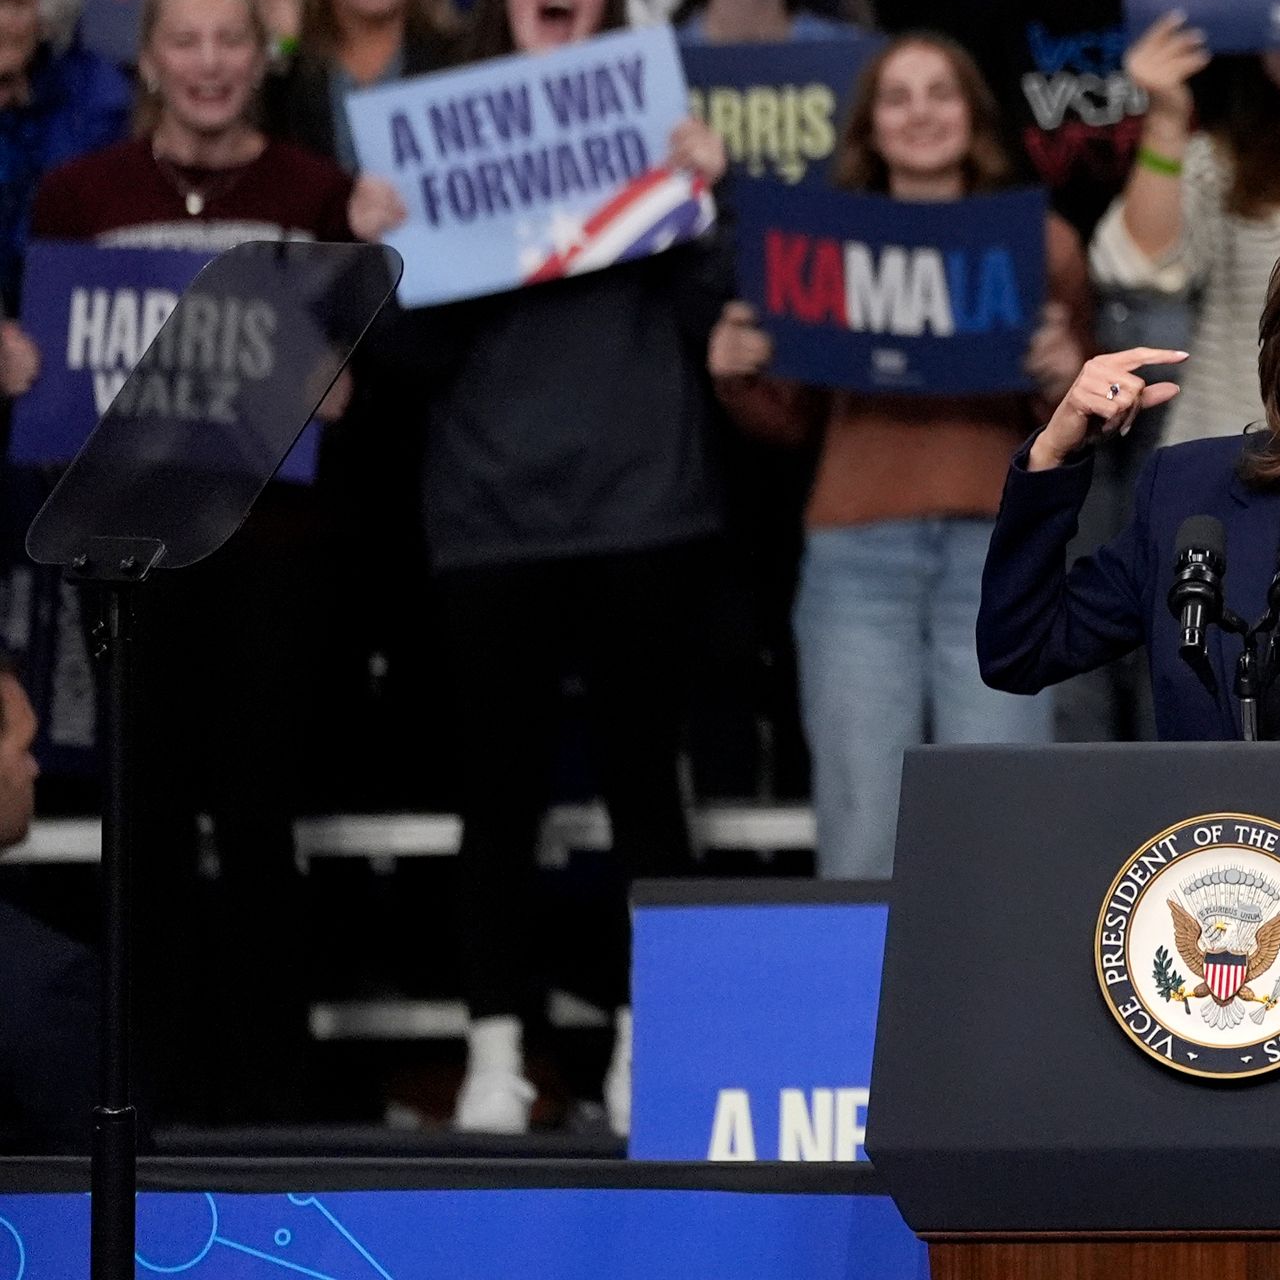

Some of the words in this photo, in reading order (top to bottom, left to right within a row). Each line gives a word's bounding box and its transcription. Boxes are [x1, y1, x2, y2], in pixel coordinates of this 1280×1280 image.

[389, 108, 424, 170] A
[427, 82, 532, 158] NEW
[543, 54, 646, 129] WAY
[690, 84, 836, 162] RRIS
[420, 126, 649, 227] FORWARD
[764, 230, 1023, 337] KAMALA
[67, 287, 276, 380] HARRIS
[1193, 824, 1223, 846] OF
[1234, 824, 1279, 852] THE
[1101, 833, 1178, 986] PRESIDENT
[1205, 905, 1238, 916] PLURIBUS
[1240, 911, 1261, 920] UNUM
[1117, 1000, 1175, 1060] VICE
[707, 1087, 757, 1161] A
[777, 1086, 871, 1161] NE
